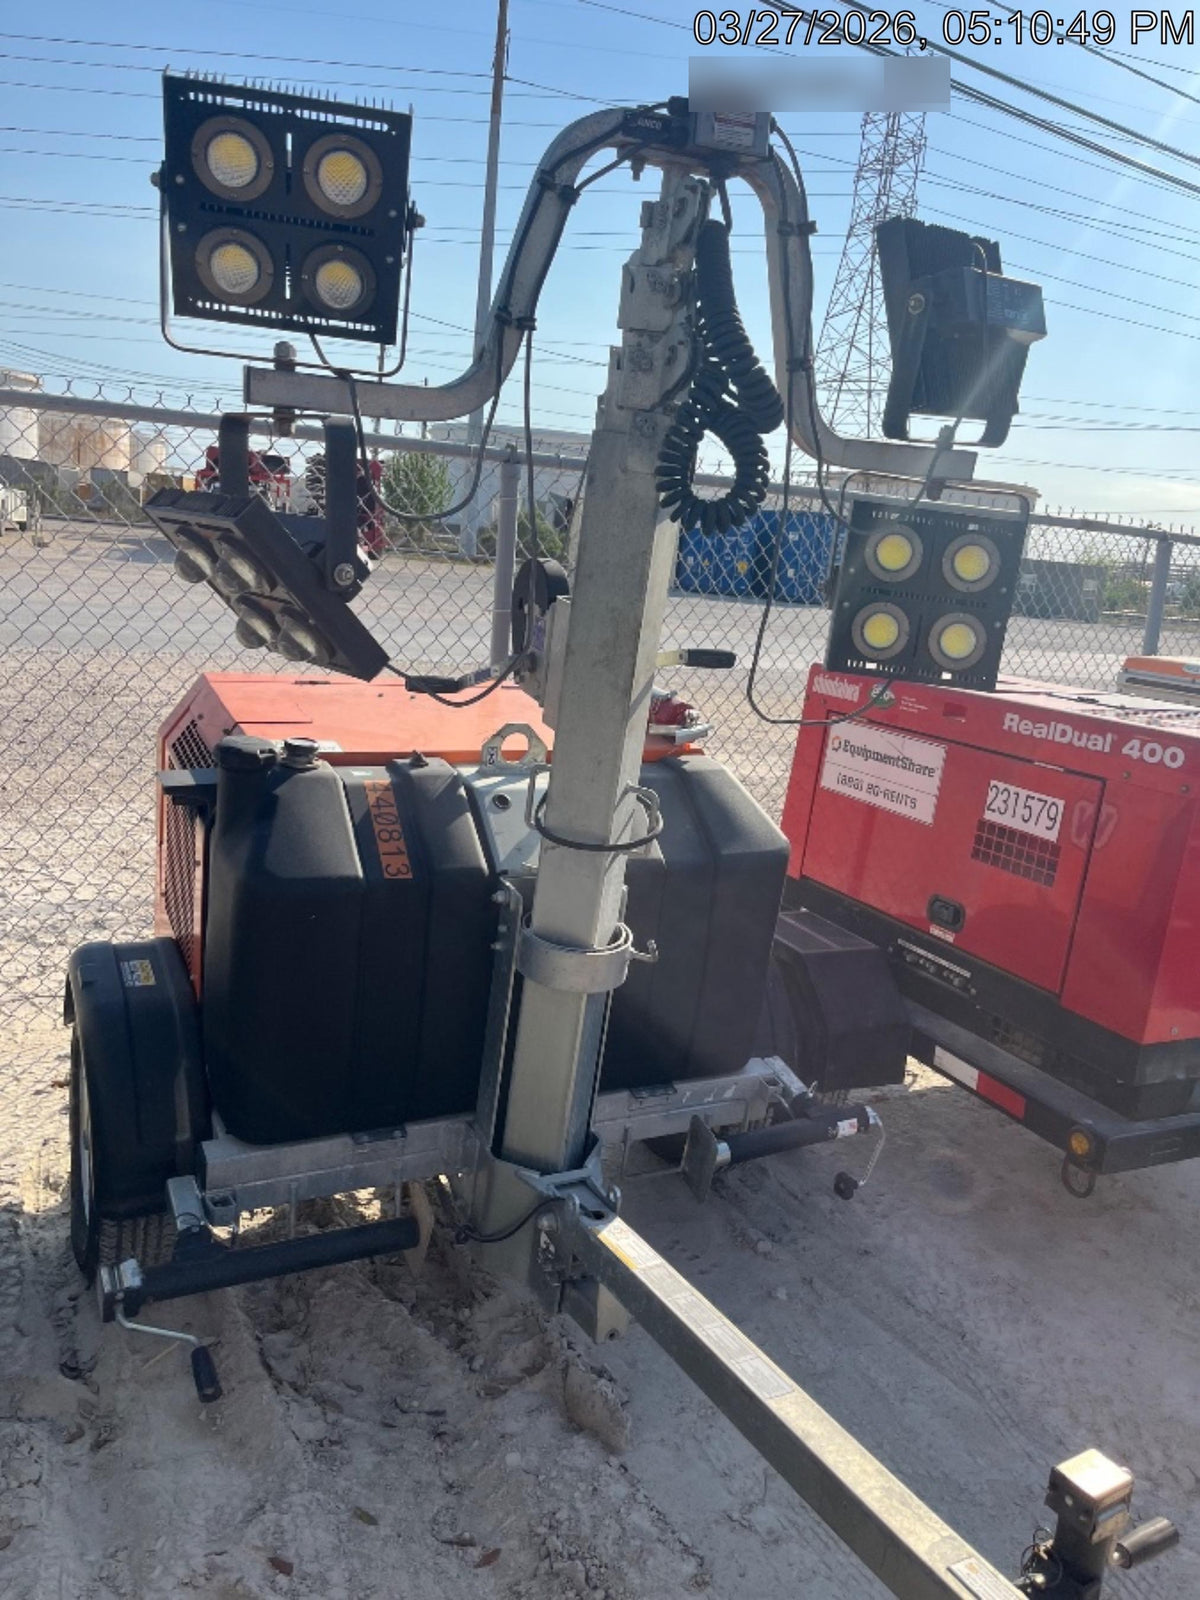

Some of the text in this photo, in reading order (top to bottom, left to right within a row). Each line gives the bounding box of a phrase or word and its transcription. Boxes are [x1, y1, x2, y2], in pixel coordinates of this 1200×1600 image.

[842, 739, 936, 778] EquipmentShare
[1003, 713, 1186, 769] RealDual 400
[368, 783, 410, 877] 440813
[986, 785, 1059, 831] 231579
